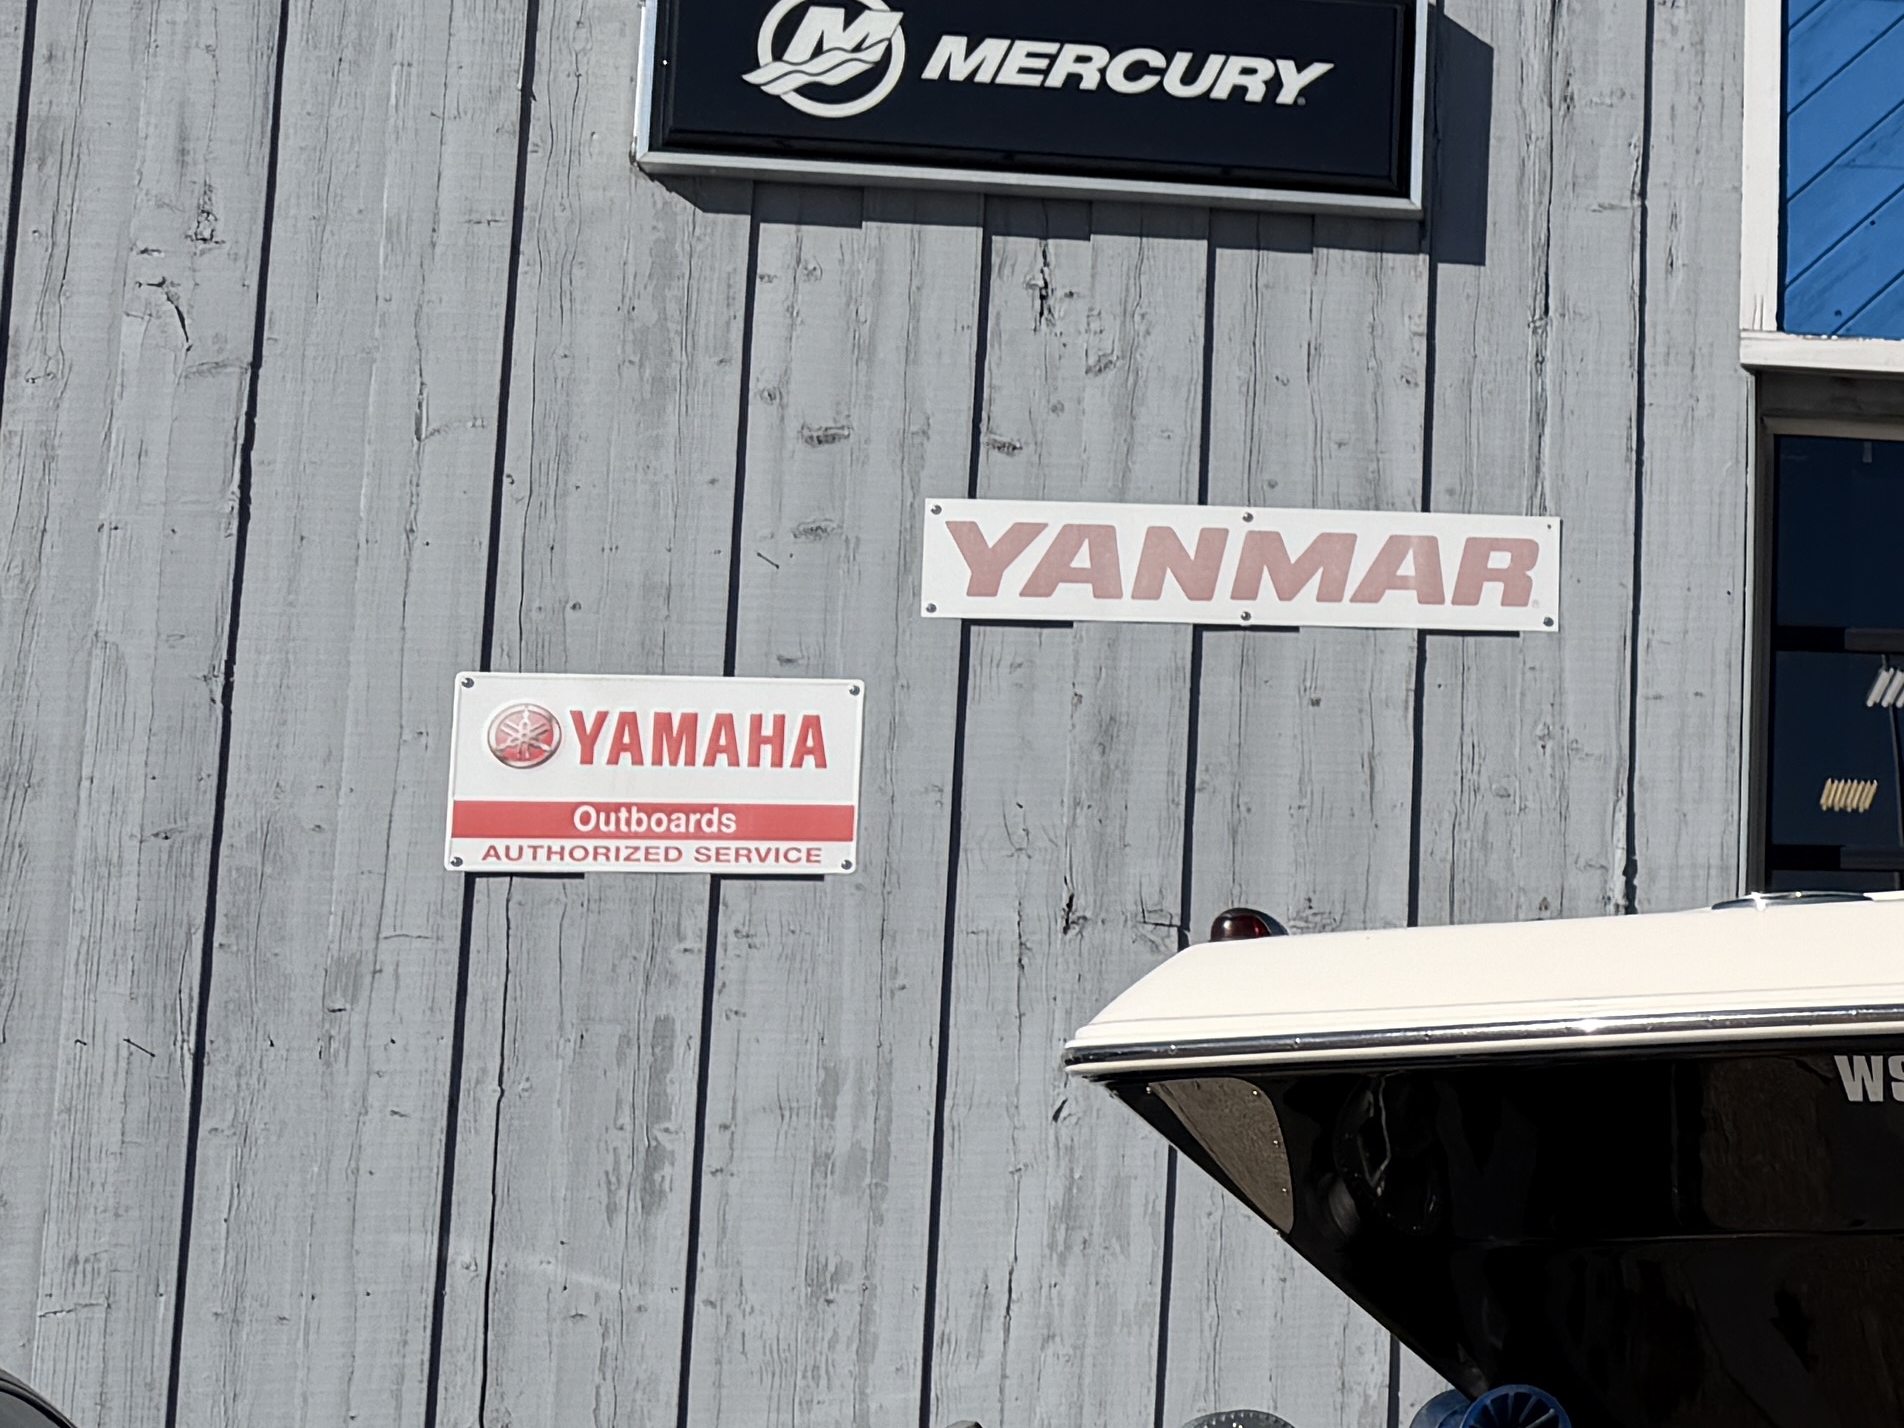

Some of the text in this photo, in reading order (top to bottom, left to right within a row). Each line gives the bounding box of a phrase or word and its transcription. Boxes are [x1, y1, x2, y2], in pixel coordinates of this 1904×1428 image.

[921, 35, 1334, 105] MERCURY
[945, 519, 1541, 607] YANMAR
[570, 710, 828, 769] YAMAHA
[572, 802, 737, 834] Outboards
[481, 843, 823, 865] AUTHORIZED SERVICE
